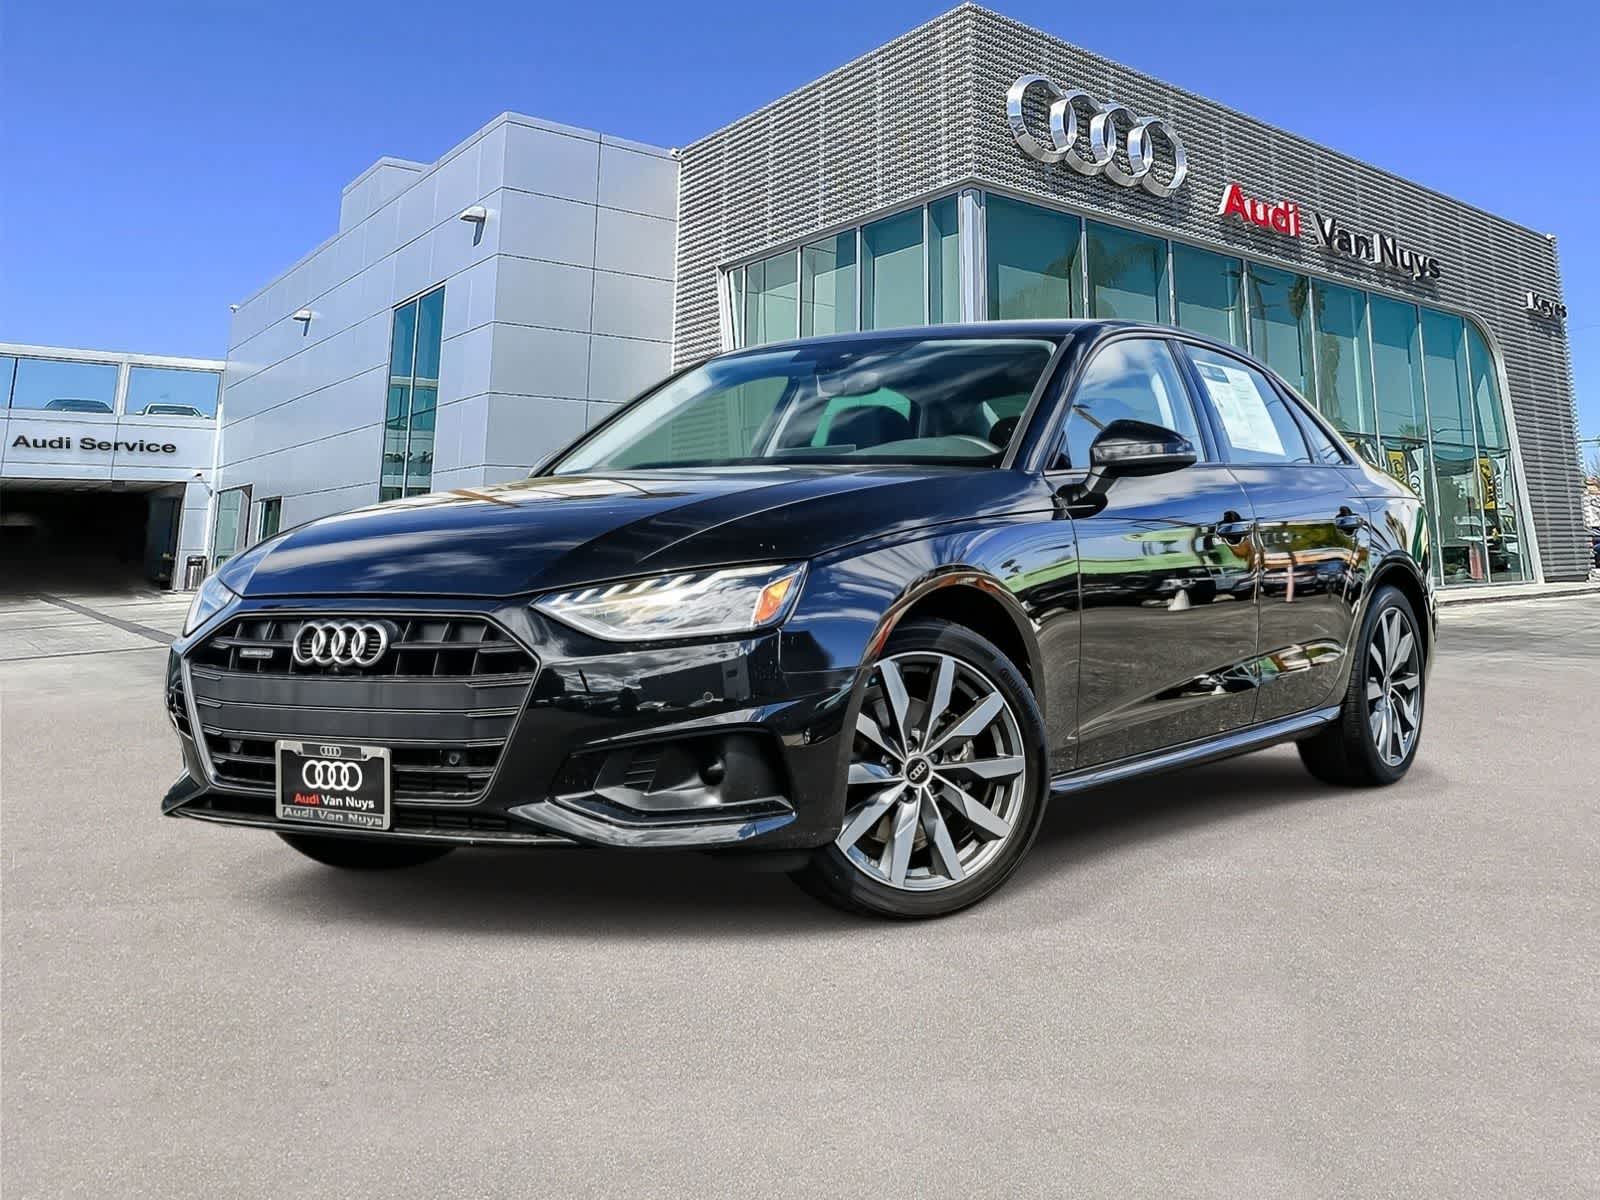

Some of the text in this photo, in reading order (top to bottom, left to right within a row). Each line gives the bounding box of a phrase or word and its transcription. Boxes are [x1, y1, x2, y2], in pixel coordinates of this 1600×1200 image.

[1219, 182, 1441, 281] Audi Van Nuys
[12, 435, 177, 453] Audi Service
[294, 793, 375, 810] Audi Van Nuys
[283, 807, 382, 826] Audi Van Nuys
